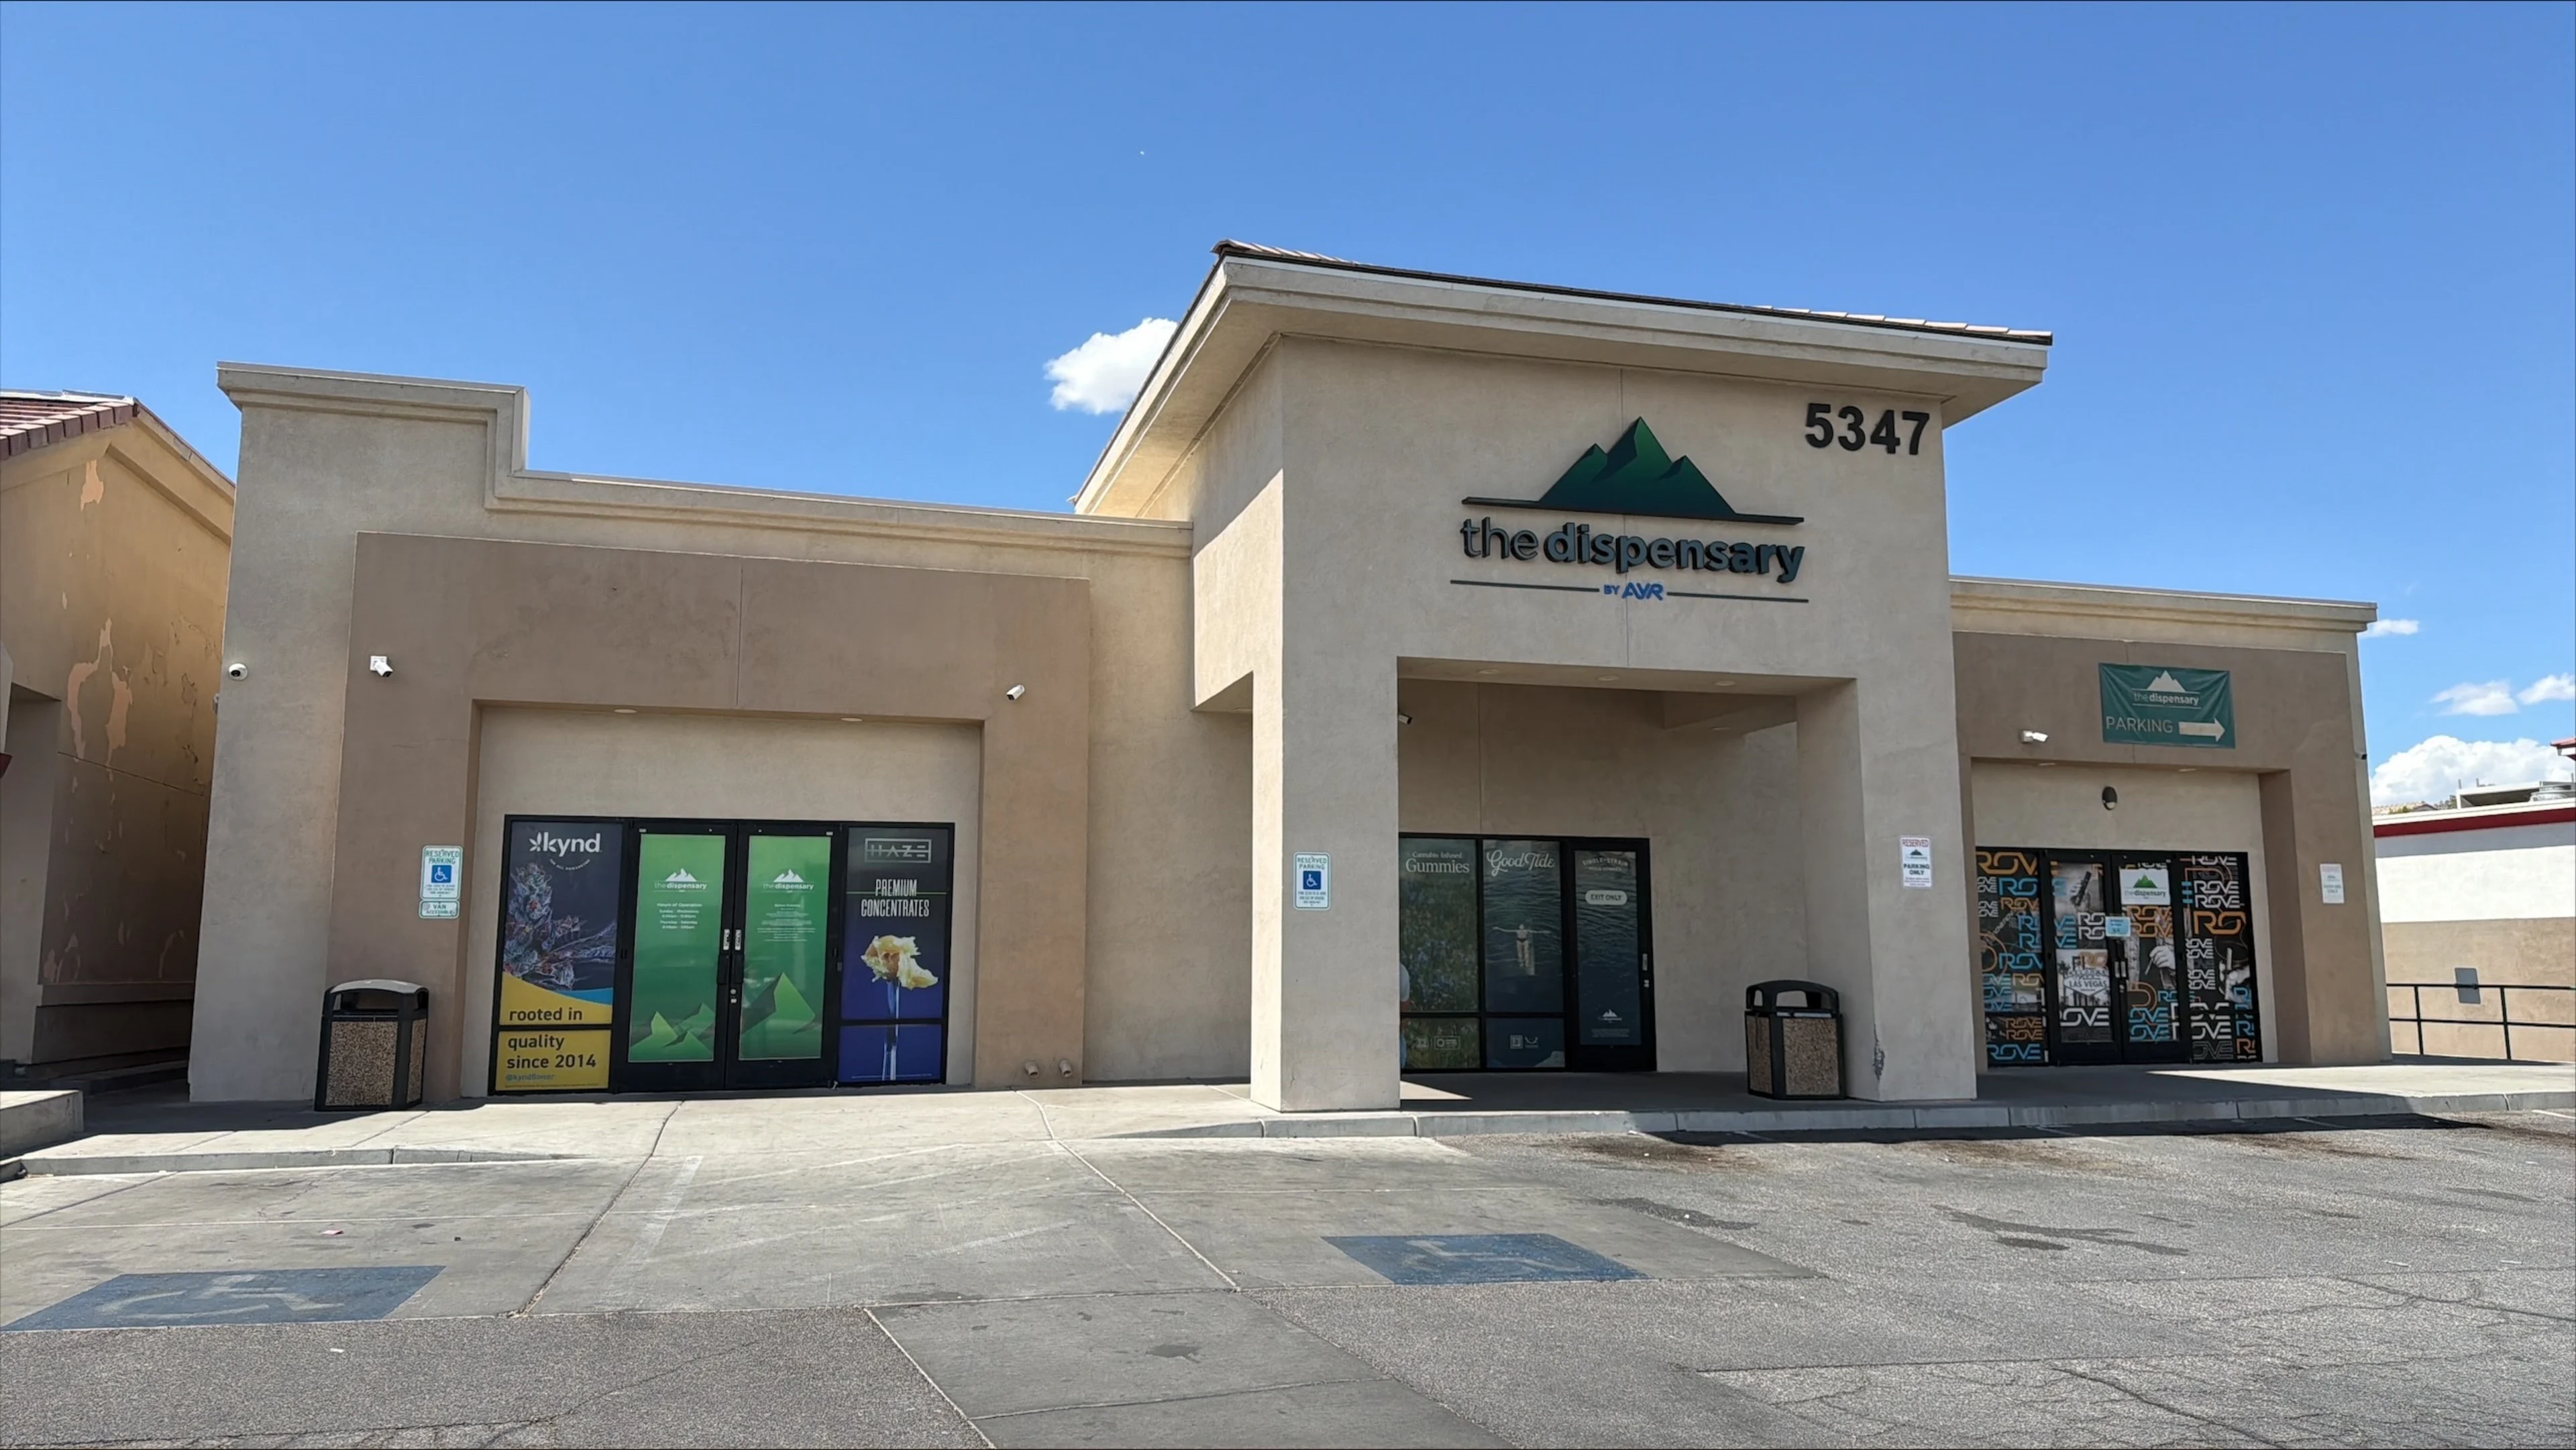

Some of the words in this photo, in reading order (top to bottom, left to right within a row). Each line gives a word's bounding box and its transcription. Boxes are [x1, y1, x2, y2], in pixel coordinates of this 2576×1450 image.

[1805, 403, 1930, 456] 5347
[1603, 584, 1620, 595] BY
[1621, 582, 1664, 601] AYR
[2106, 716, 2174, 733] PARKING
[542, 831, 601, 858] kynd
[425, 850, 460, 858] RESERVED
[1405, 858, 1470, 874] Gummies
[1486, 849, 1525, 877] Good
[1523, 852, 1555, 871] Tide
[1976, 850, 2039, 876] ROV
[875, 878, 918, 897] PREMIUM
[2193, 880, 2240, 894] ROVE
[861, 898, 930, 917] CONCENTRATES
[2194, 894, 2241, 909] ROVE
[2084, 980, 2107, 988] VEGAS
[509, 1007, 562, 1021] rooted
[568, 1007, 582, 1021] in
[2005, 1017, 2043, 1029] ROVE
[2006, 1028, 2043, 1040] ROVE
[508, 1034, 565, 1051] quality
[507, 1055, 549, 1069] since
[555, 1054, 596, 1068] 2014
